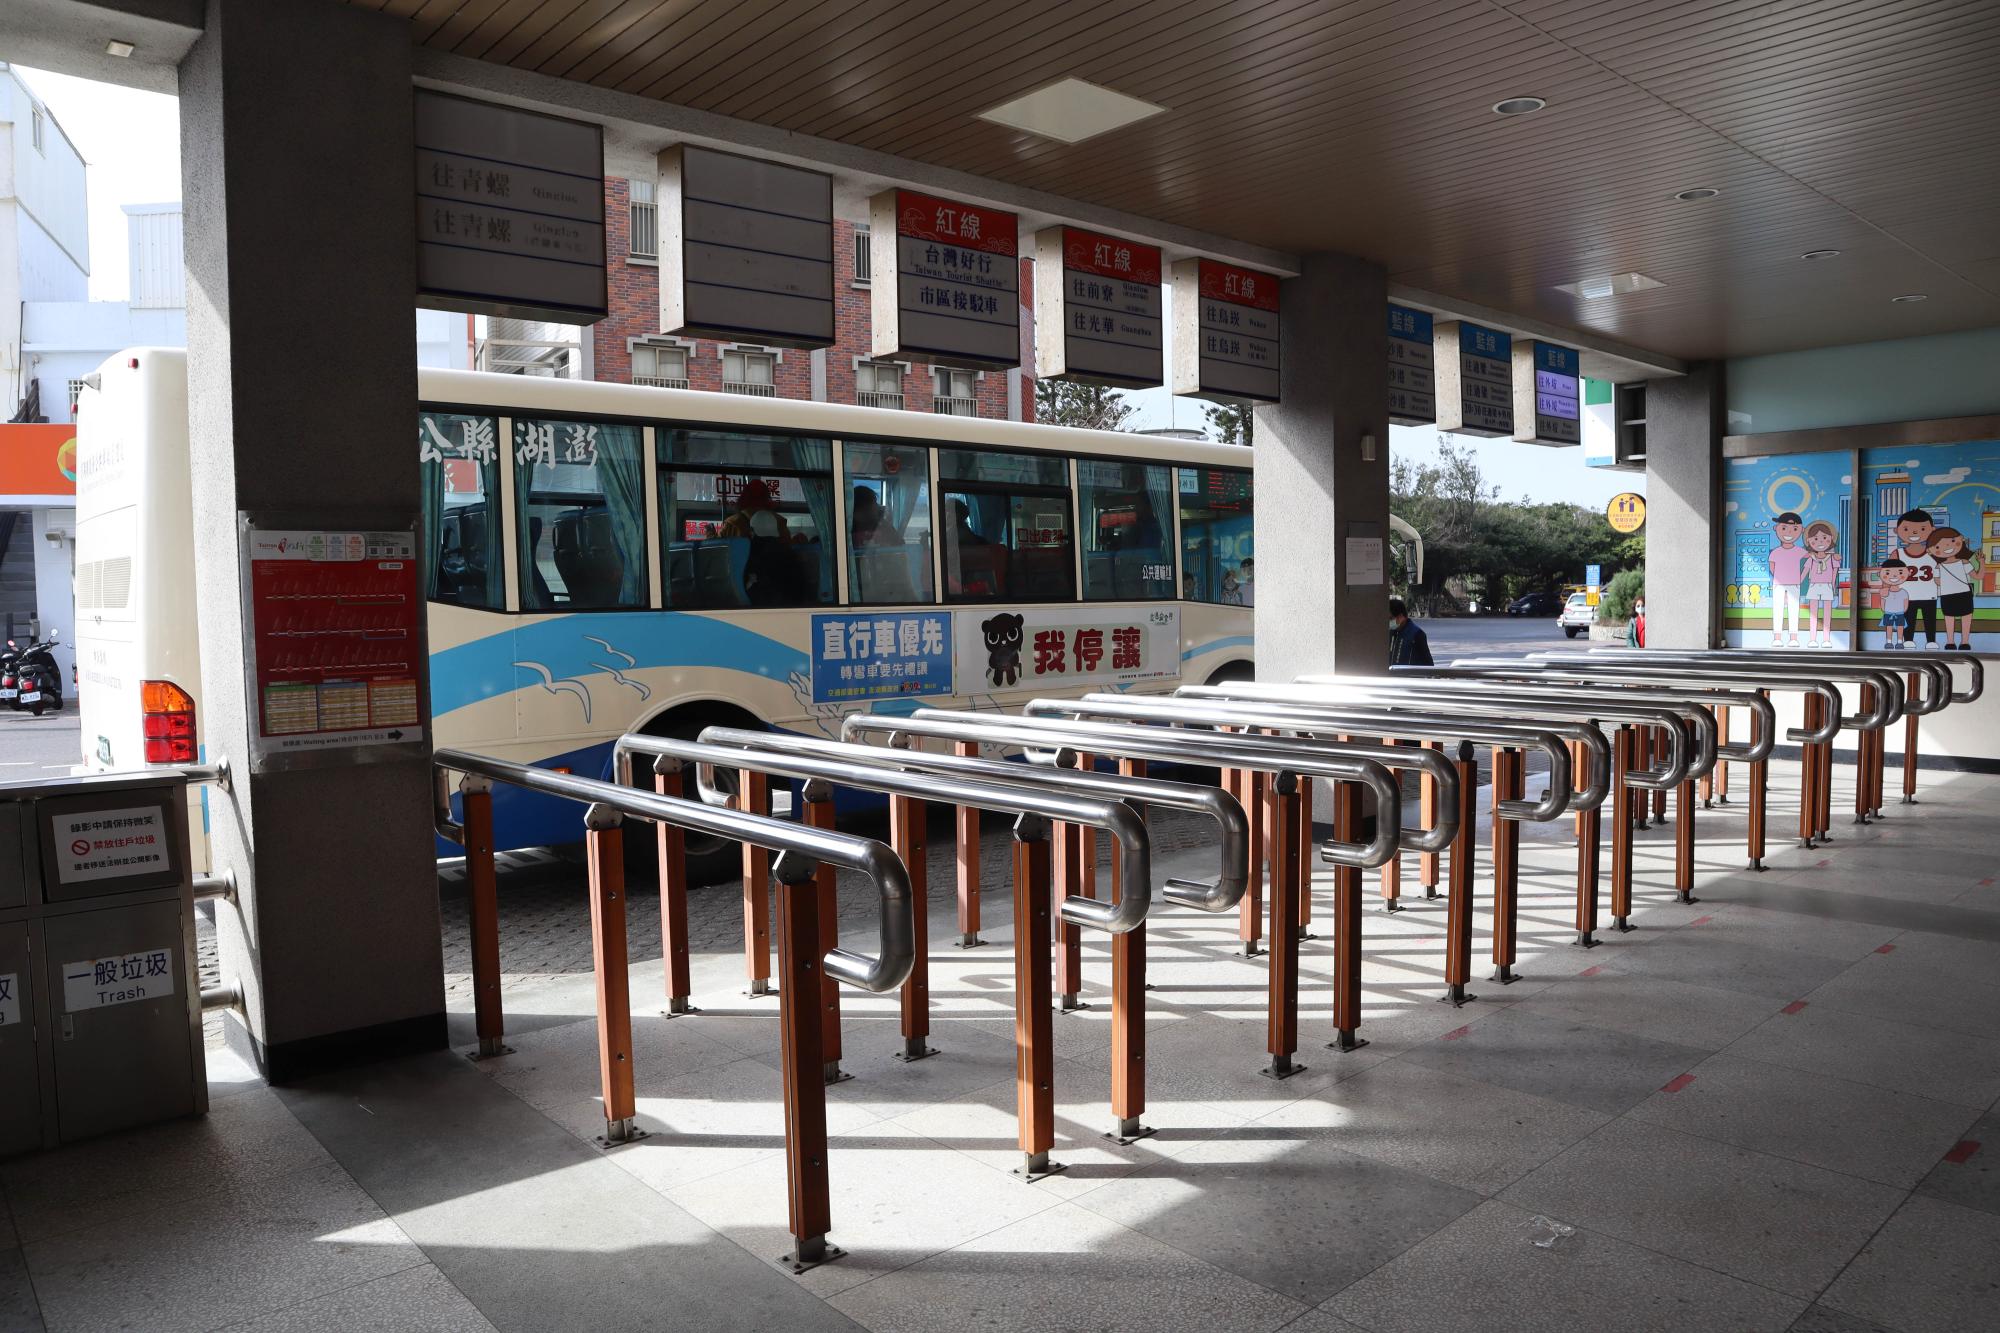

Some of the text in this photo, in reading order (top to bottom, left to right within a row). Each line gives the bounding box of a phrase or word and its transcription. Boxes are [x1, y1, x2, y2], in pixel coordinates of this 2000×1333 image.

[432, 161, 510, 199] 往青螺
[433, 208, 511, 244] 往青螺
[936, 206, 981, 240] 紅線
[926, 244, 993, 275] 台灣好行
[1094, 241, 1132, 272] 紅線
[914, 264, 942, 277] Taiwan
[947, 270, 973, 283] Tourist
[1225, 272, 1256, 299] 紅線
[920, 286, 998, 316] 市區接駁車
[1073, 278, 1113, 304] 往前寮
[1074, 311, 1115, 335] 往光華
[1906, 565, 1933, 581] 23
[822, 618, 944, 661] 直行車優先
[1033, 626, 1141, 675] 我停讓
[70, 816, 154, 833] 錄影中請保持微笑
[93, 834, 156, 850] 禁放住戶垃圾
[67, 952, 168, 986] 一般垃圾
[97, 985, 146, 1004] Trash
